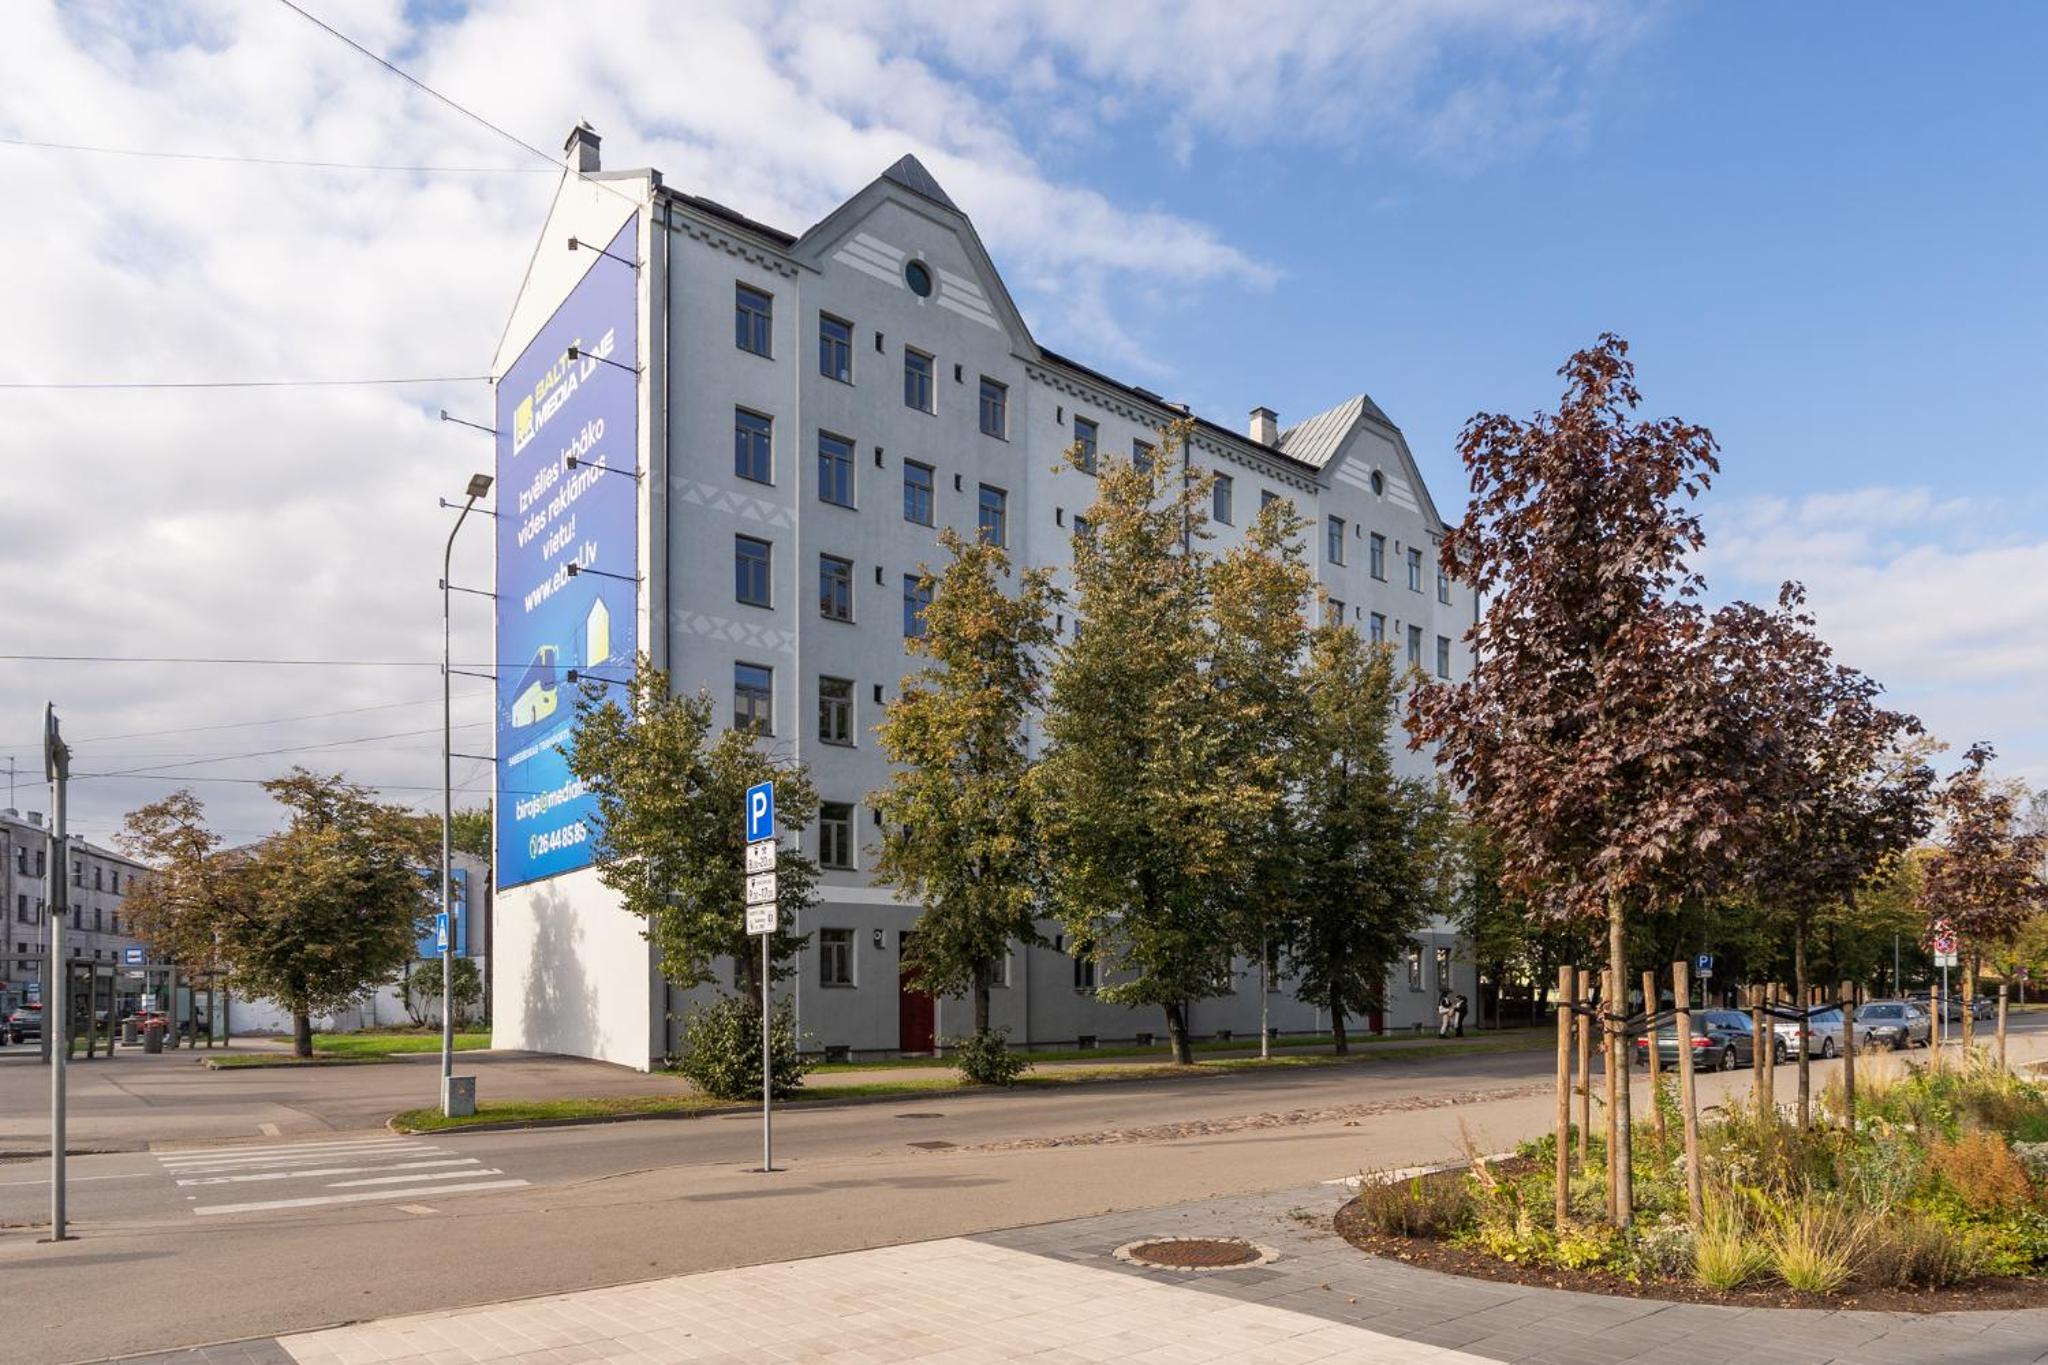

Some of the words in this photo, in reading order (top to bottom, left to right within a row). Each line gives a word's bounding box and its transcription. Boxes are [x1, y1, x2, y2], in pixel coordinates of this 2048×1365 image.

[535, 372, 579, 433] MEDIA
[581, 328, 614, 384] LINE
[518, 510, 547, 548] vides
[548, 454, 606, 522] reklāmas
[519, 462, 560, 514] Izvēlies
[542, 513, 576, 561] vietu!
[752, 791, 767, 834] P
[1699, 955, 1709, 967] P
